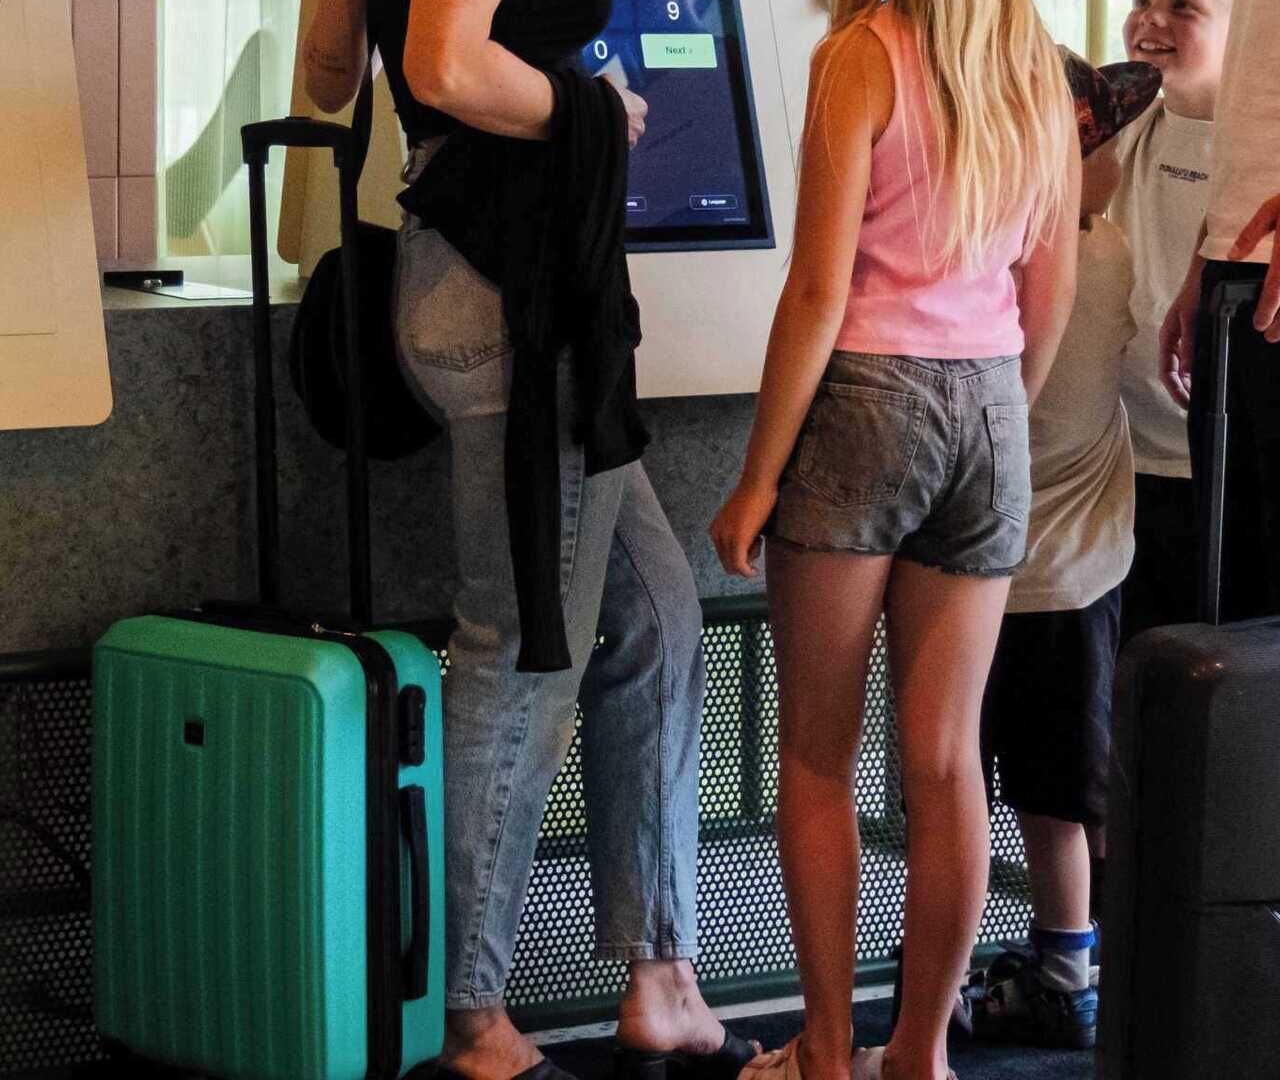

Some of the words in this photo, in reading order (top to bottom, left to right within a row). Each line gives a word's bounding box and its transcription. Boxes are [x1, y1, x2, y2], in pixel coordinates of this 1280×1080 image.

[667, 1, 680, 21] 9
[593, 40, 609, 60] 0
[664, 45, 687, 55] Next
